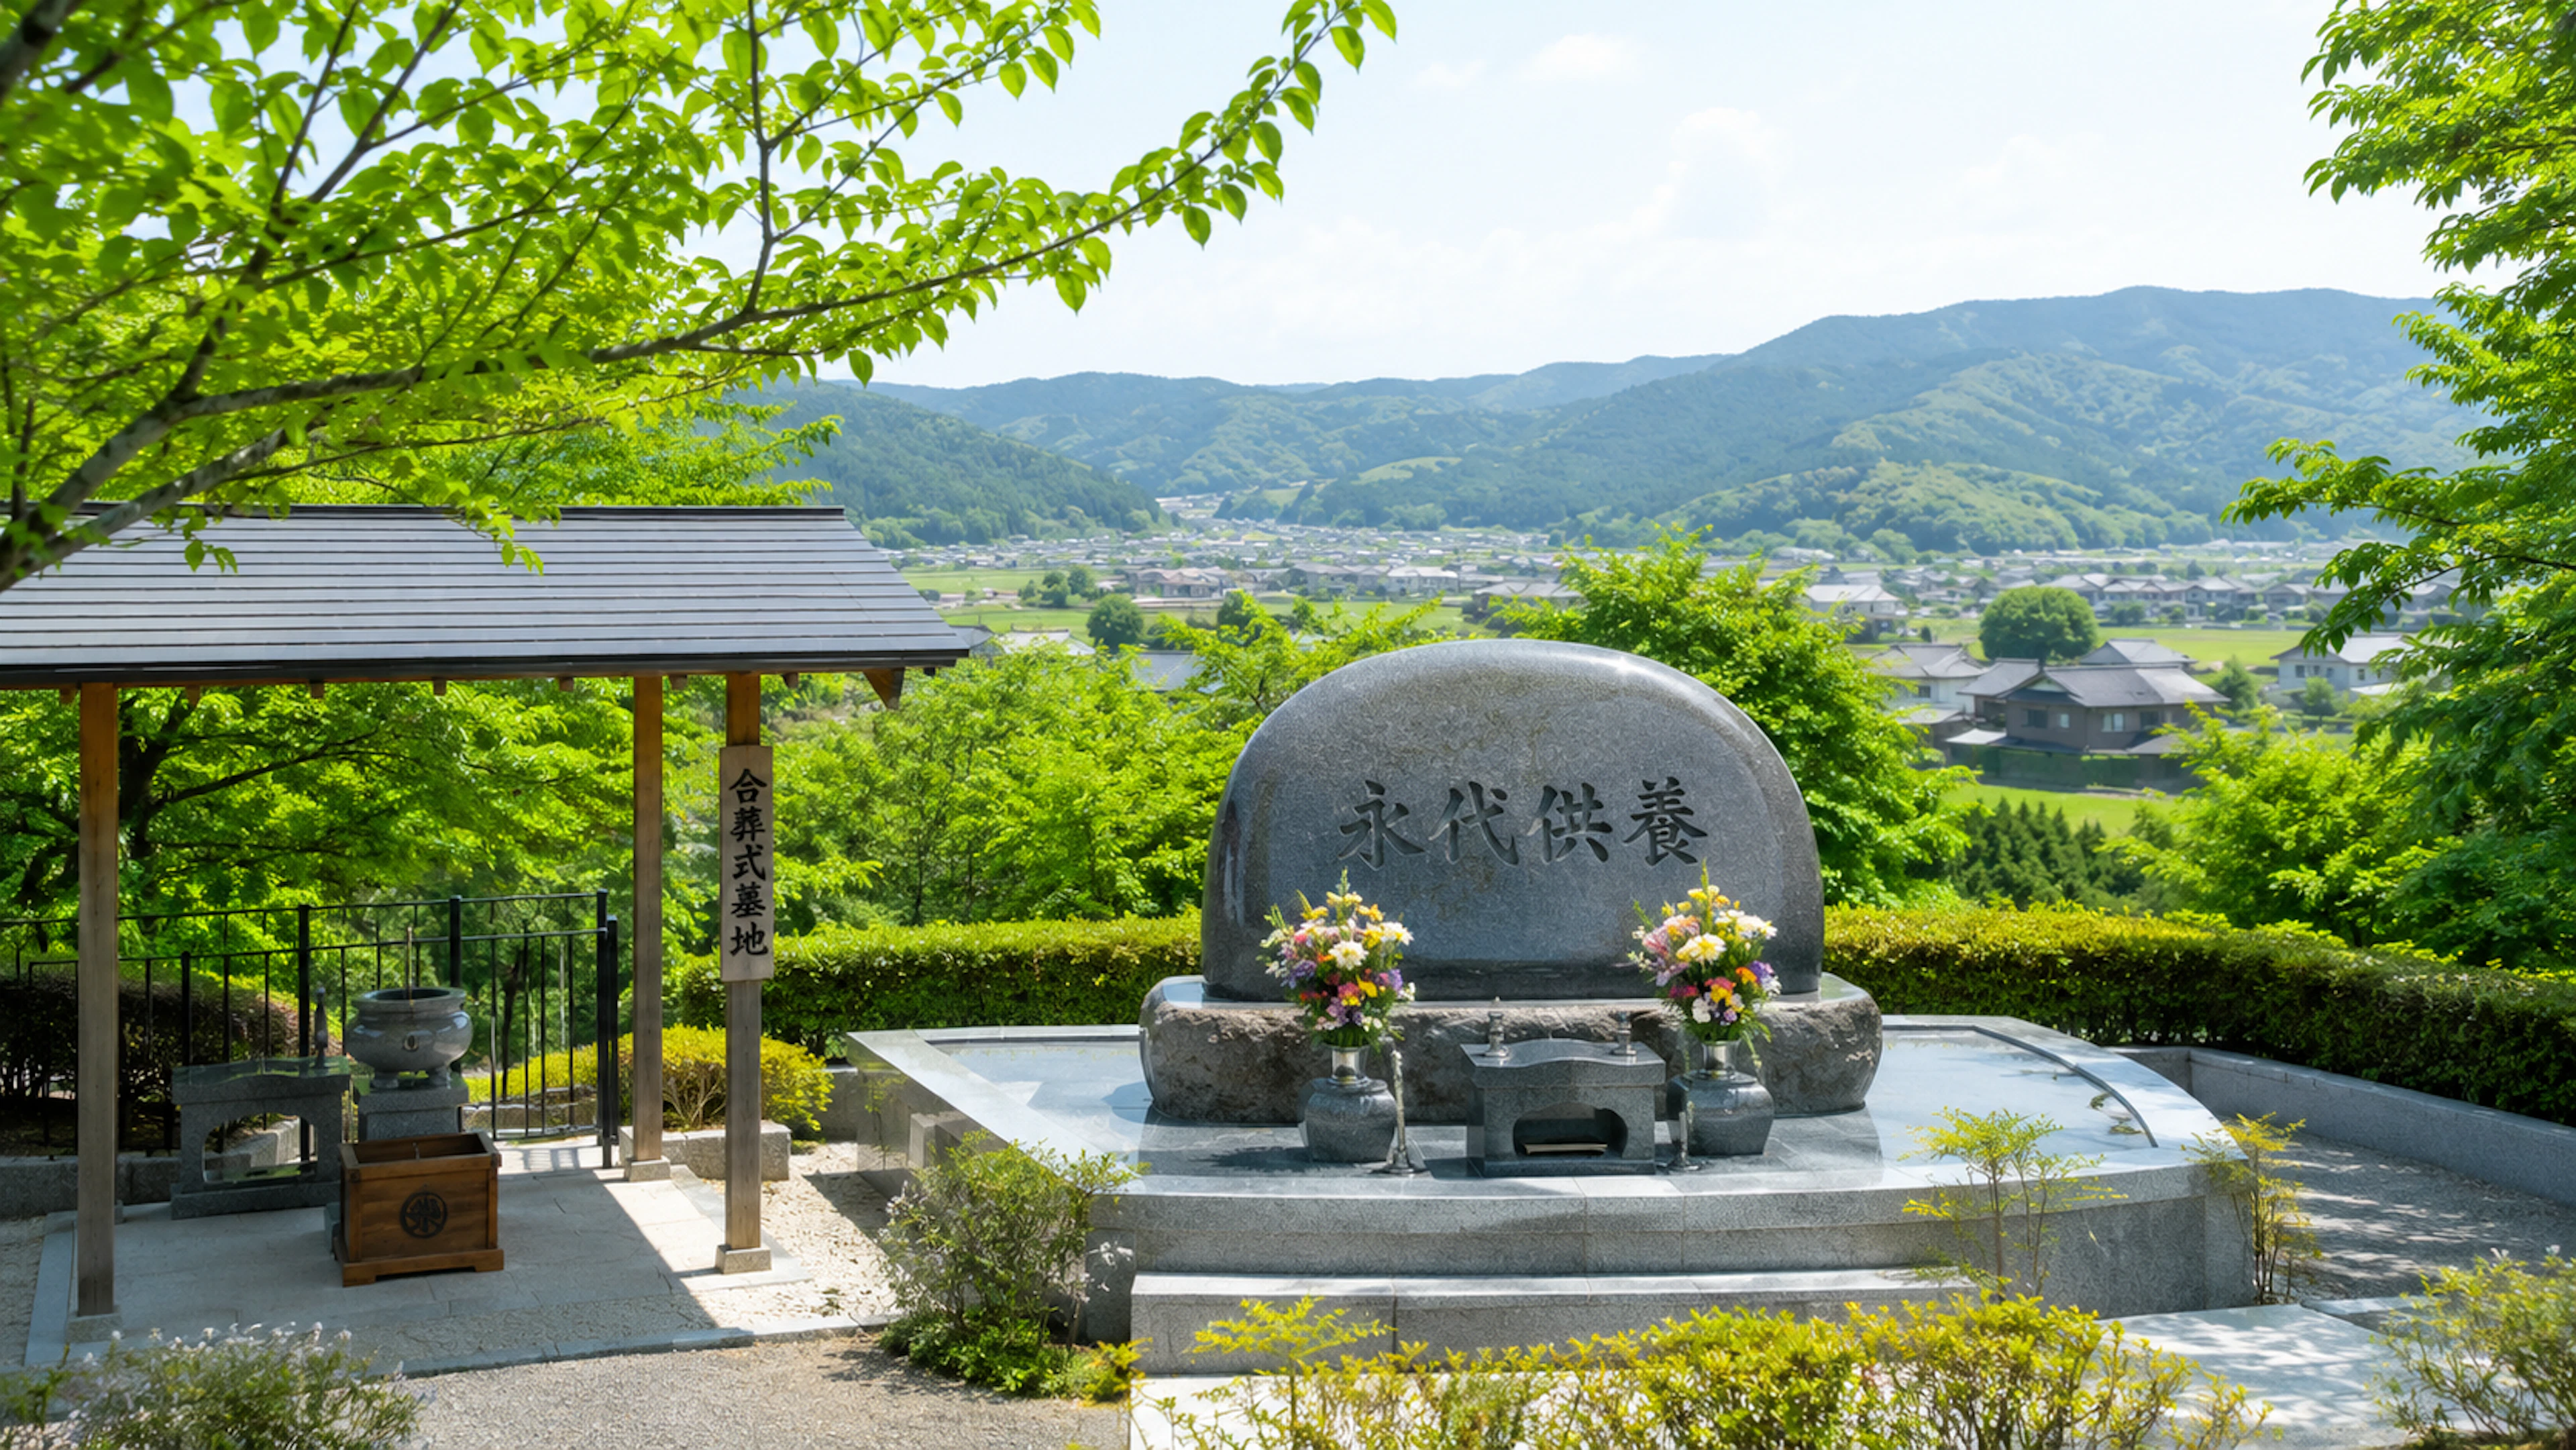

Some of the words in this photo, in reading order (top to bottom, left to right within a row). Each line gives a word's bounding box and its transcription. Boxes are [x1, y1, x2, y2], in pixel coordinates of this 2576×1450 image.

[729, 768, 768, 957] 合葬式墓地
[1338, 776, 1708, 871] 永代供養
